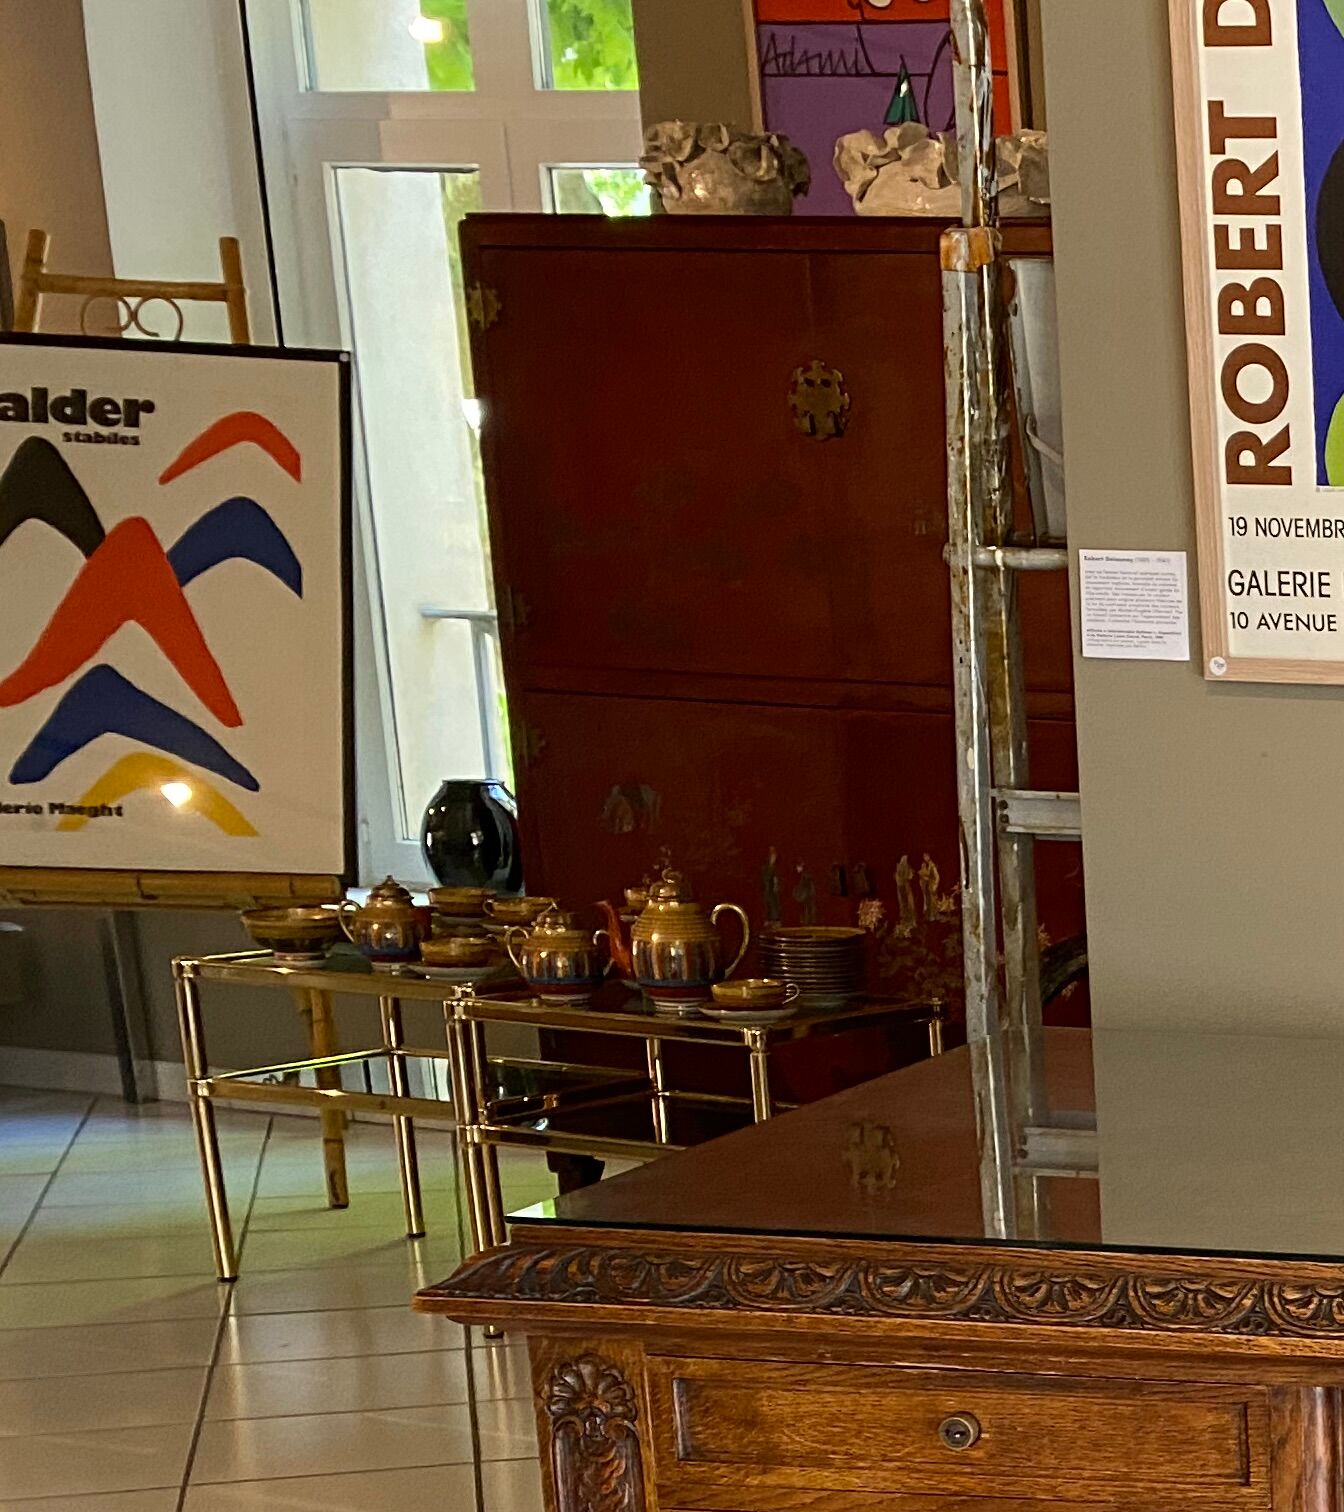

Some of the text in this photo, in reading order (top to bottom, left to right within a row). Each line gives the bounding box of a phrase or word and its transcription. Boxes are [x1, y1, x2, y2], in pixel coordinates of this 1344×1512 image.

[1208, 100, 1292, 485] ROBERT
[62, 432, 140, 445] stabiles
[1228, 517, 1248, 537] 19
[1228, 570, 1331, 598] GALERIE
[1230, 611, 1249, 629] 10
[1256, 613, 1337, 632] AVENUE
